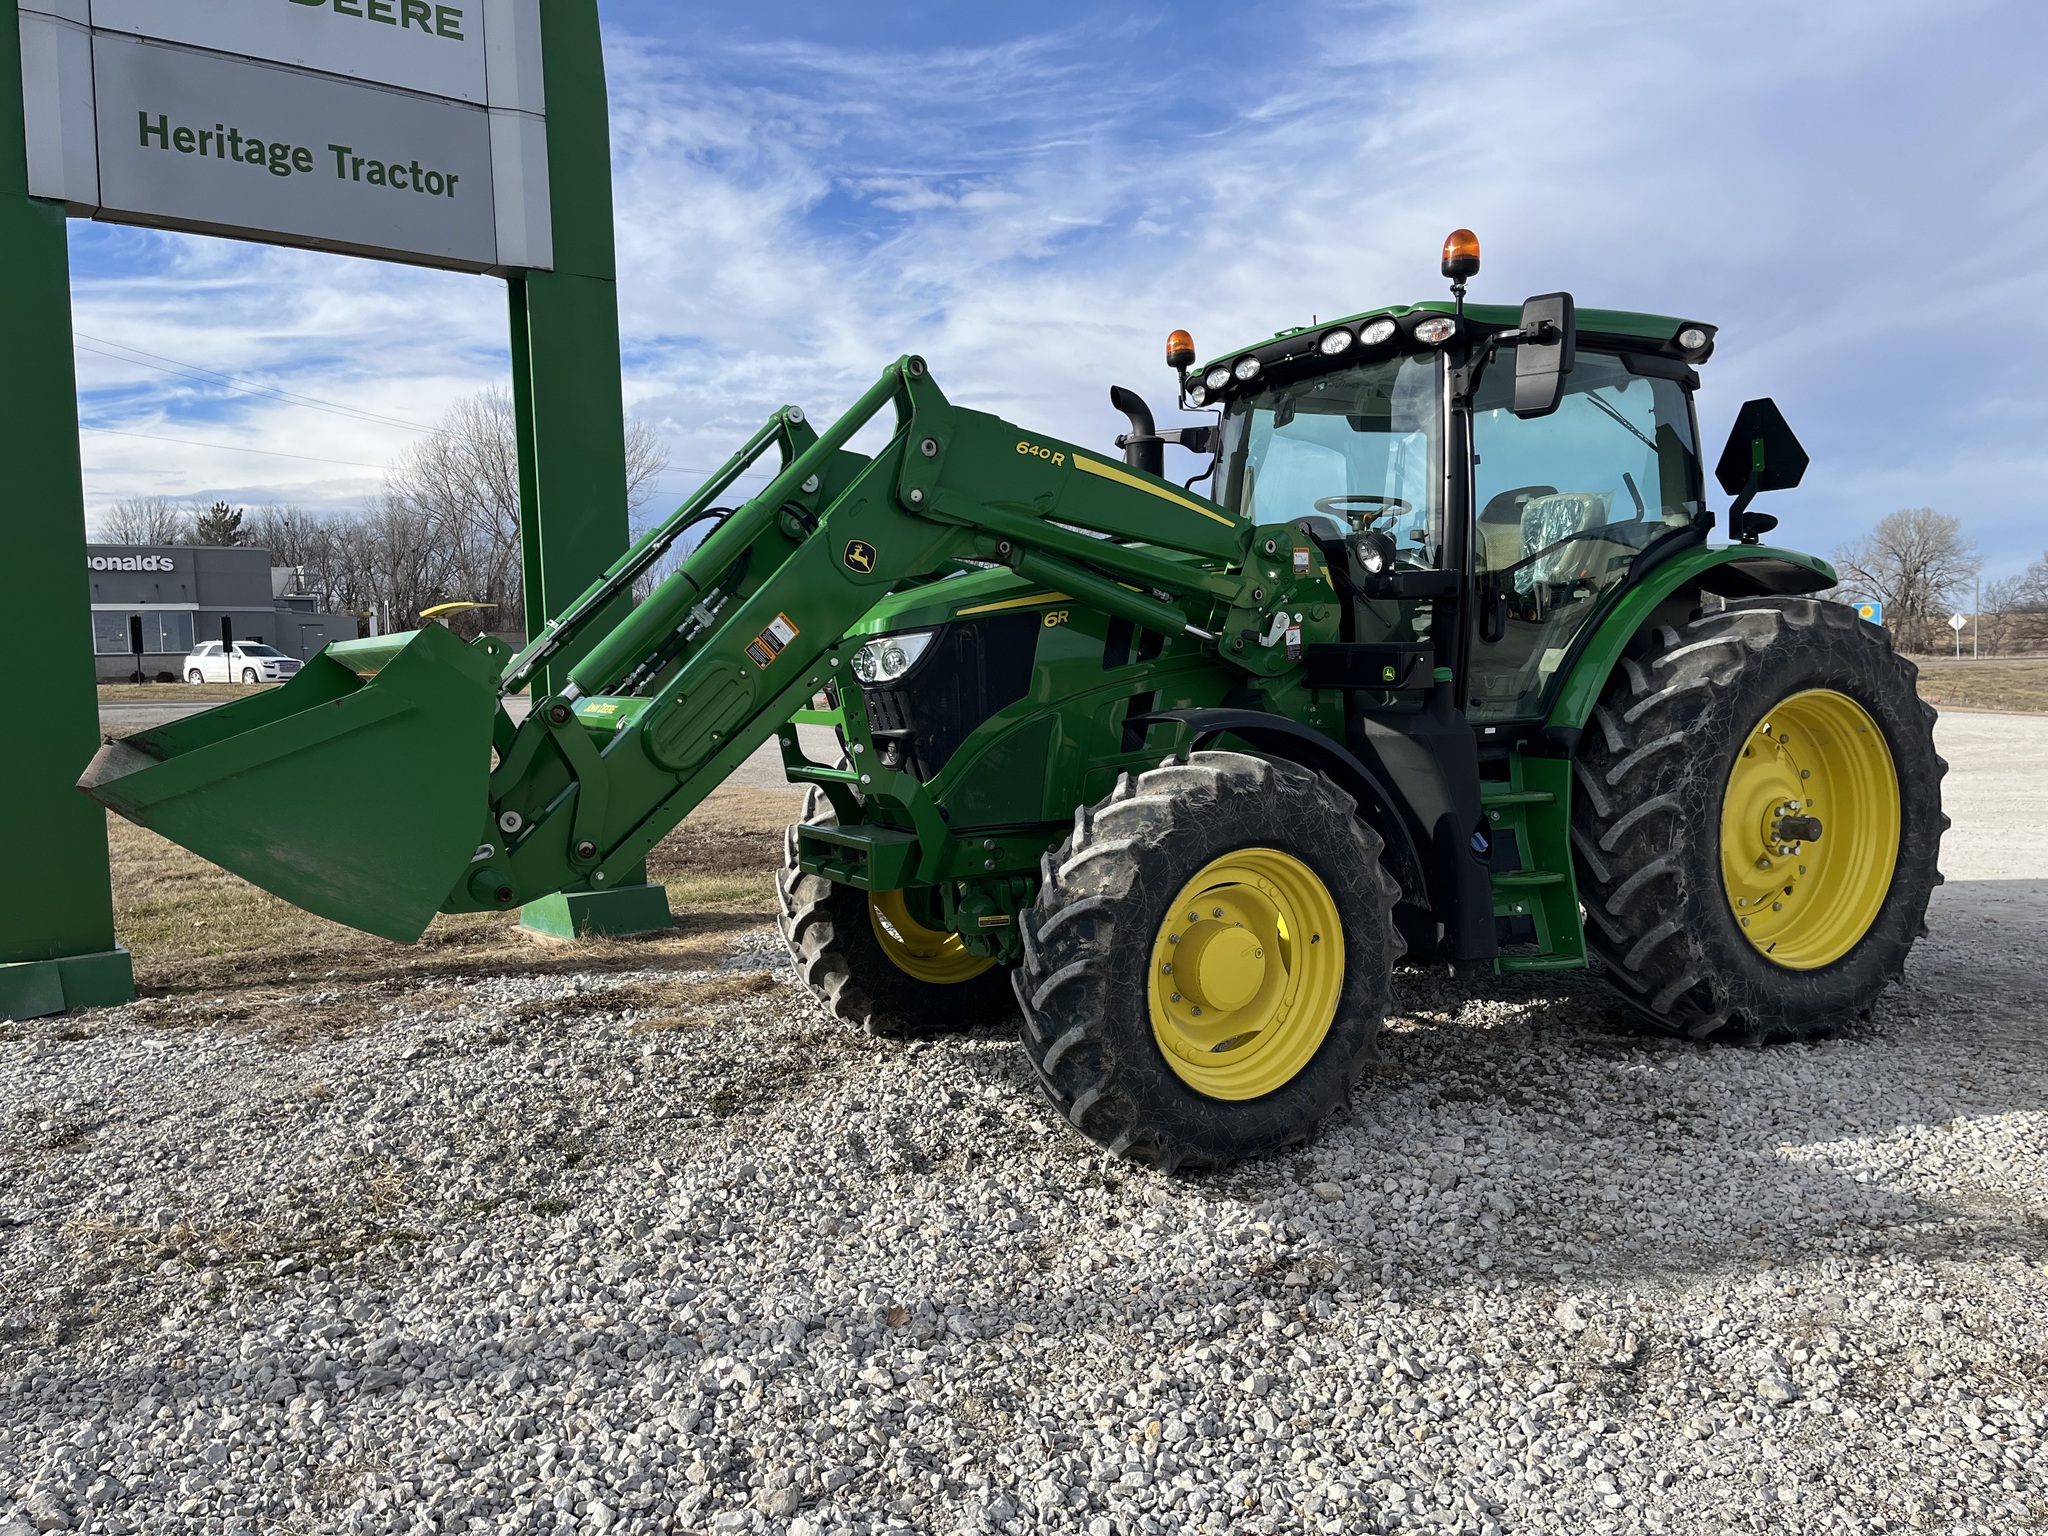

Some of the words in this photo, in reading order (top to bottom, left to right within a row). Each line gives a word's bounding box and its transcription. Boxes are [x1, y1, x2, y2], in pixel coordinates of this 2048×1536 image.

[289, 0, 464, 41] ERE
[138, 111, 314, 177] Heritage
[327, 143, 459, 198] Tractor
[87, 555, 174, 571] onald's
[1044, 610, 1069, 627] 6R
